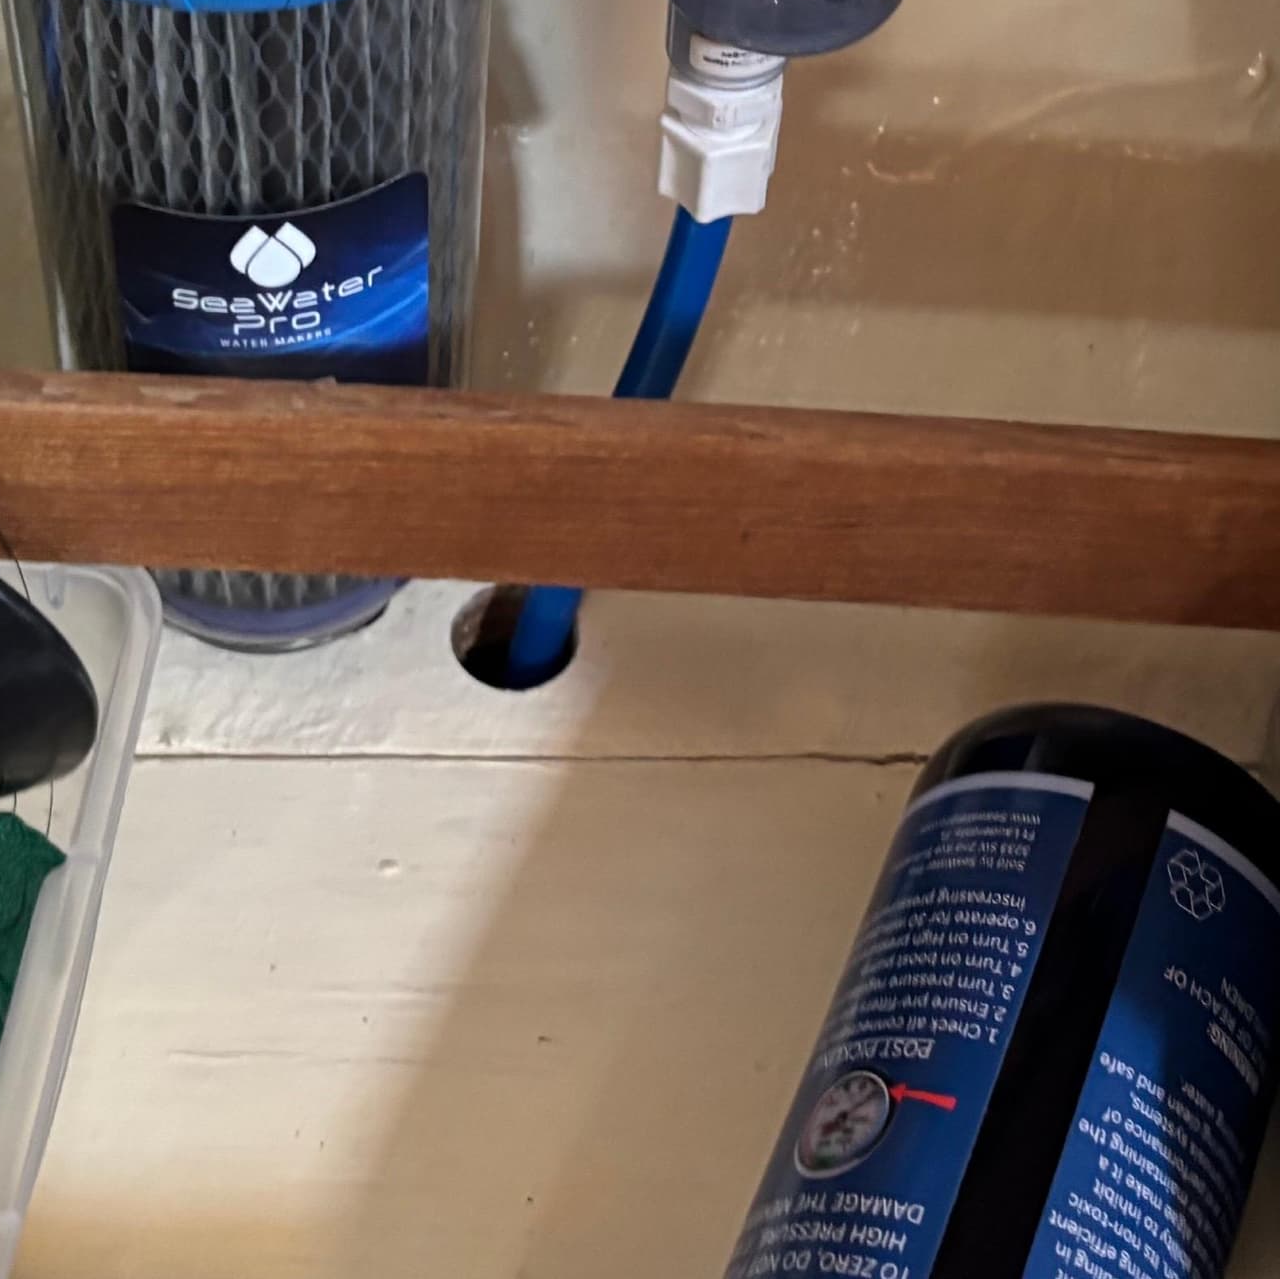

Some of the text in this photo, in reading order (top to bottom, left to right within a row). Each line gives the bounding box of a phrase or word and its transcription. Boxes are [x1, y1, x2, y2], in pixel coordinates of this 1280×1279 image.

[172, 265, 383, 314] SeaWater
[233, 311, 321, 336] Pro
[220, 327, 332, 349] WATER MAKERS
[954, 909, 1019, 930] operate
[948, 930, 969, 946] on
[972, 932, 1010, 954] Turn
[940, 952, 961, 968] on
[965, 952, 1002, 974] Turn
[958, 974, 994, 996] Turn
[1163, 965, 1188, 990] OF
[931, 997, 988, 1018] Ensure
[931, 1015, 981, 1039] Check
[1099, 1051, 1135, 1080] safe
[1135, 1072, 1165, 1101] and
[1101, 1106, 1122, 1123] of
[1078, 1117, 1106, 1145] the
[1110, 1162, 1122, 1184] it
[1092, 1177, 1141, 1226] inhibit
[1125, 1172, 1162, 1210] make
[831, 1191, 924, 1224] DAMAGE
[1067, 1191, 1142, 1251] non-toxic
[850, 1222, 907, 1253] HIGH
[1047, 1208, 1117, 1260] efficient
